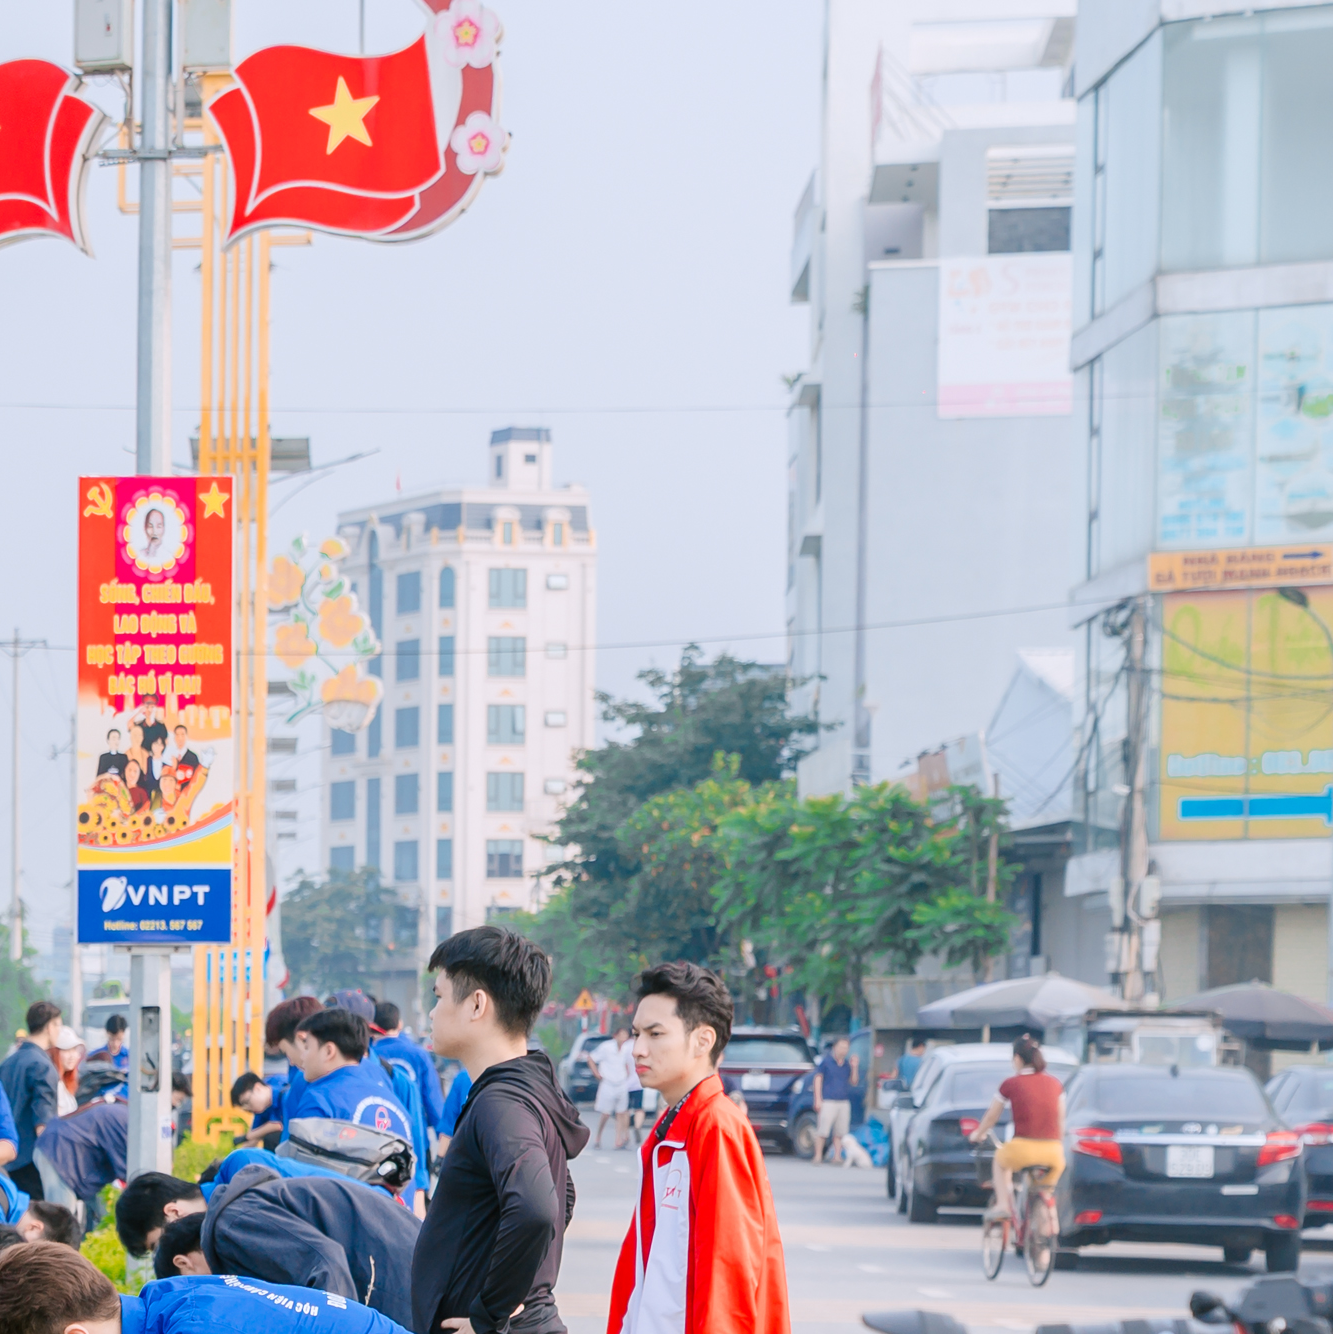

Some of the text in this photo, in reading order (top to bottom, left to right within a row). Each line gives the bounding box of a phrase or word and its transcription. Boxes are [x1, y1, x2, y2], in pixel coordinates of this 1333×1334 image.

[113, 610, 197, 638] LAO ĐỘNG VÀ
[86, 644, 114, 668] HỌC
[115, 640, 142, 668] TẬP
[143, 644, 177, 664] THEO
[108, 671, 135, 695] BÁC
[137, 669, 157, 695] HỒ
[127, 884, 211, 906] VNPT
[103, 919, 138, 931] Hotline:
[266, 1292, 294, 1310] VIỆN
[295, 1301, 319, 1316] HỌC
